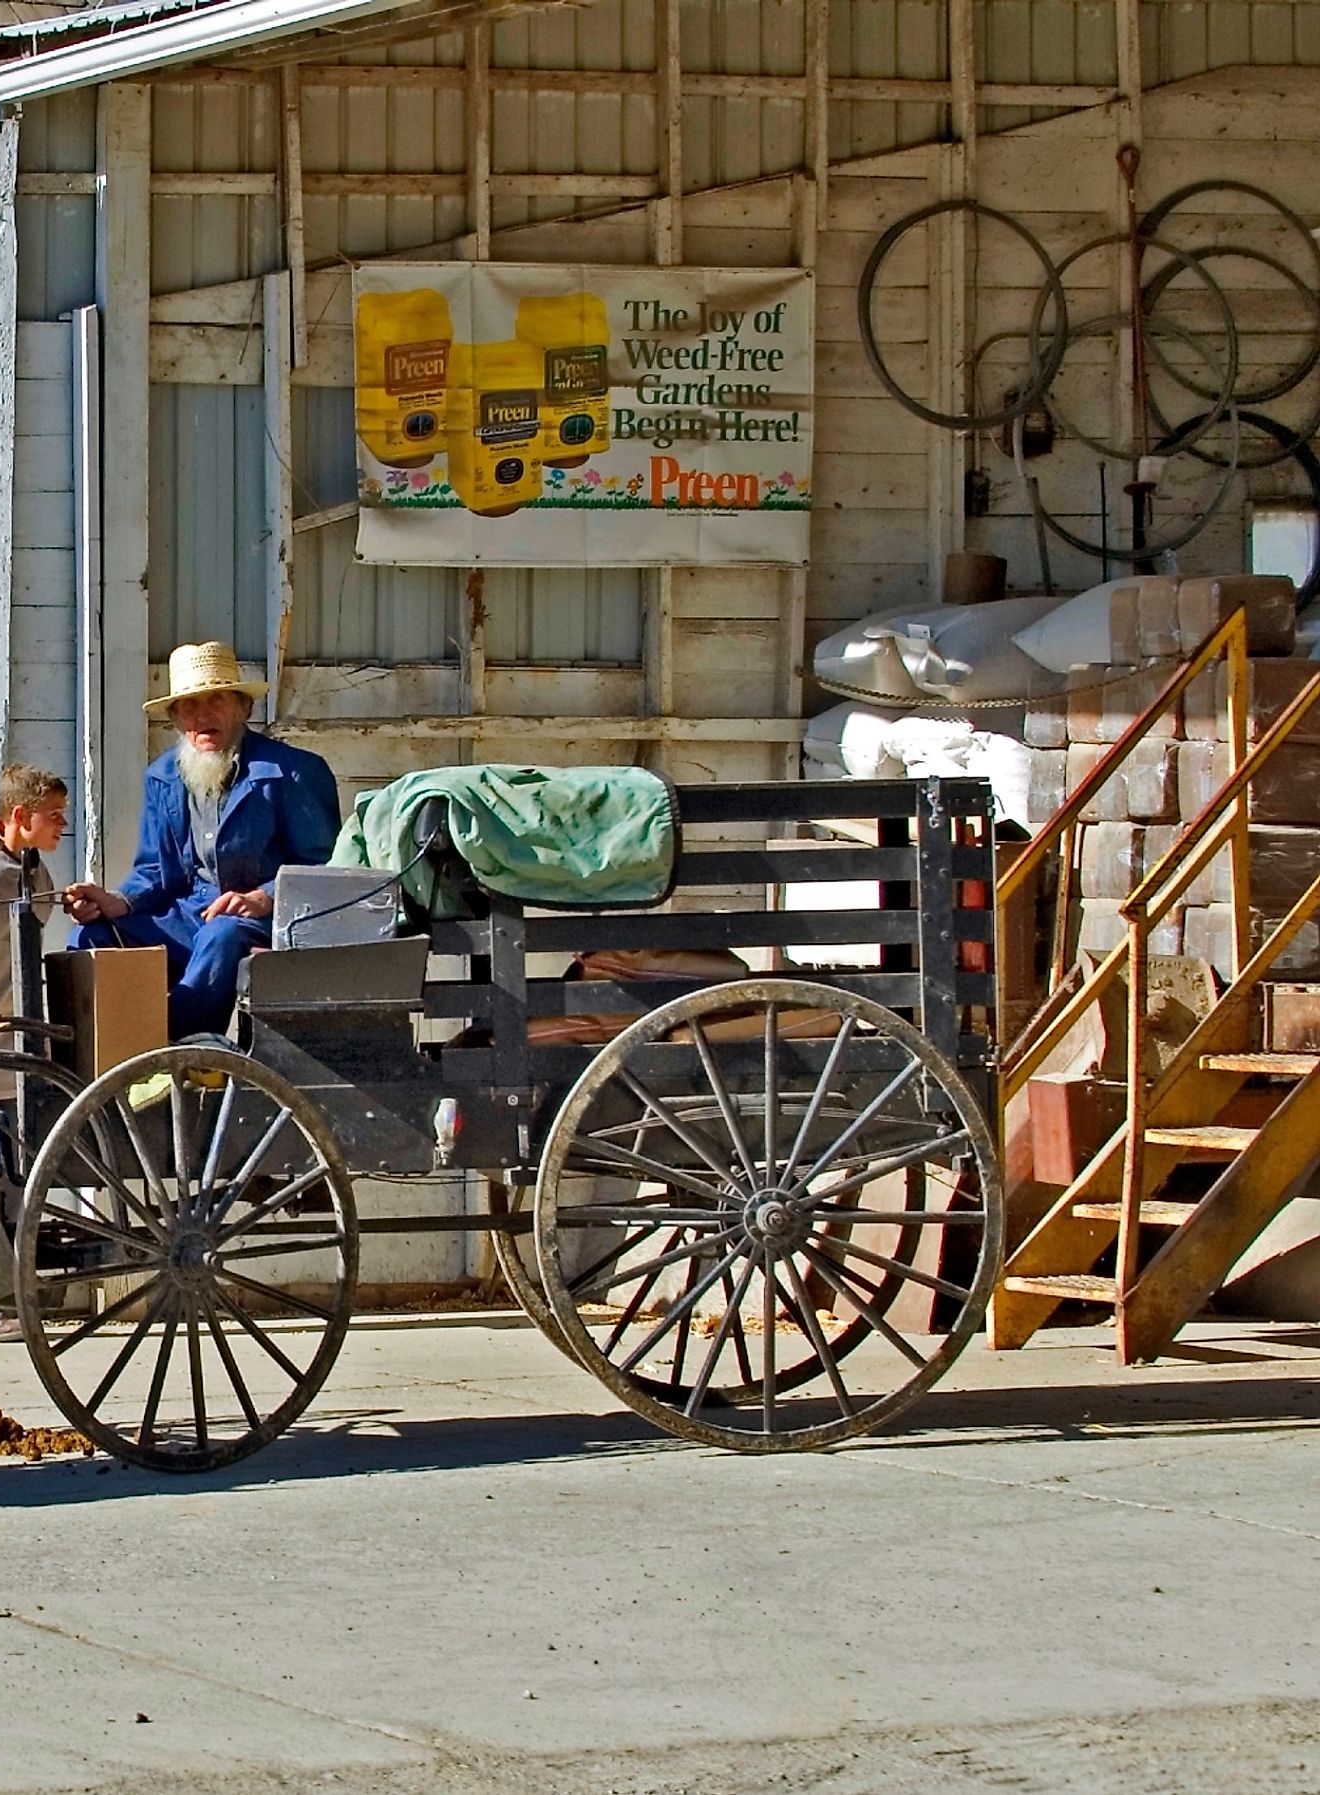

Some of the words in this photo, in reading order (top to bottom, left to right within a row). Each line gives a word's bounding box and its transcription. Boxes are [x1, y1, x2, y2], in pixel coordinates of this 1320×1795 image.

[624, 300, 688, 332] The
[696, 302, 745, 341] Joy
[754, 302, 787, 334] of
[394, 357, 444, 380] Preen
[622, 339, 784, 371] Weed-Free
[636, 373, 772, 407] Gardens
[488, 406, 531, 423] Preen
[612, 408, 709, 449] Begin
[716, 410, 800, 443] Here!
[649, 456, 760, 508] Preen
